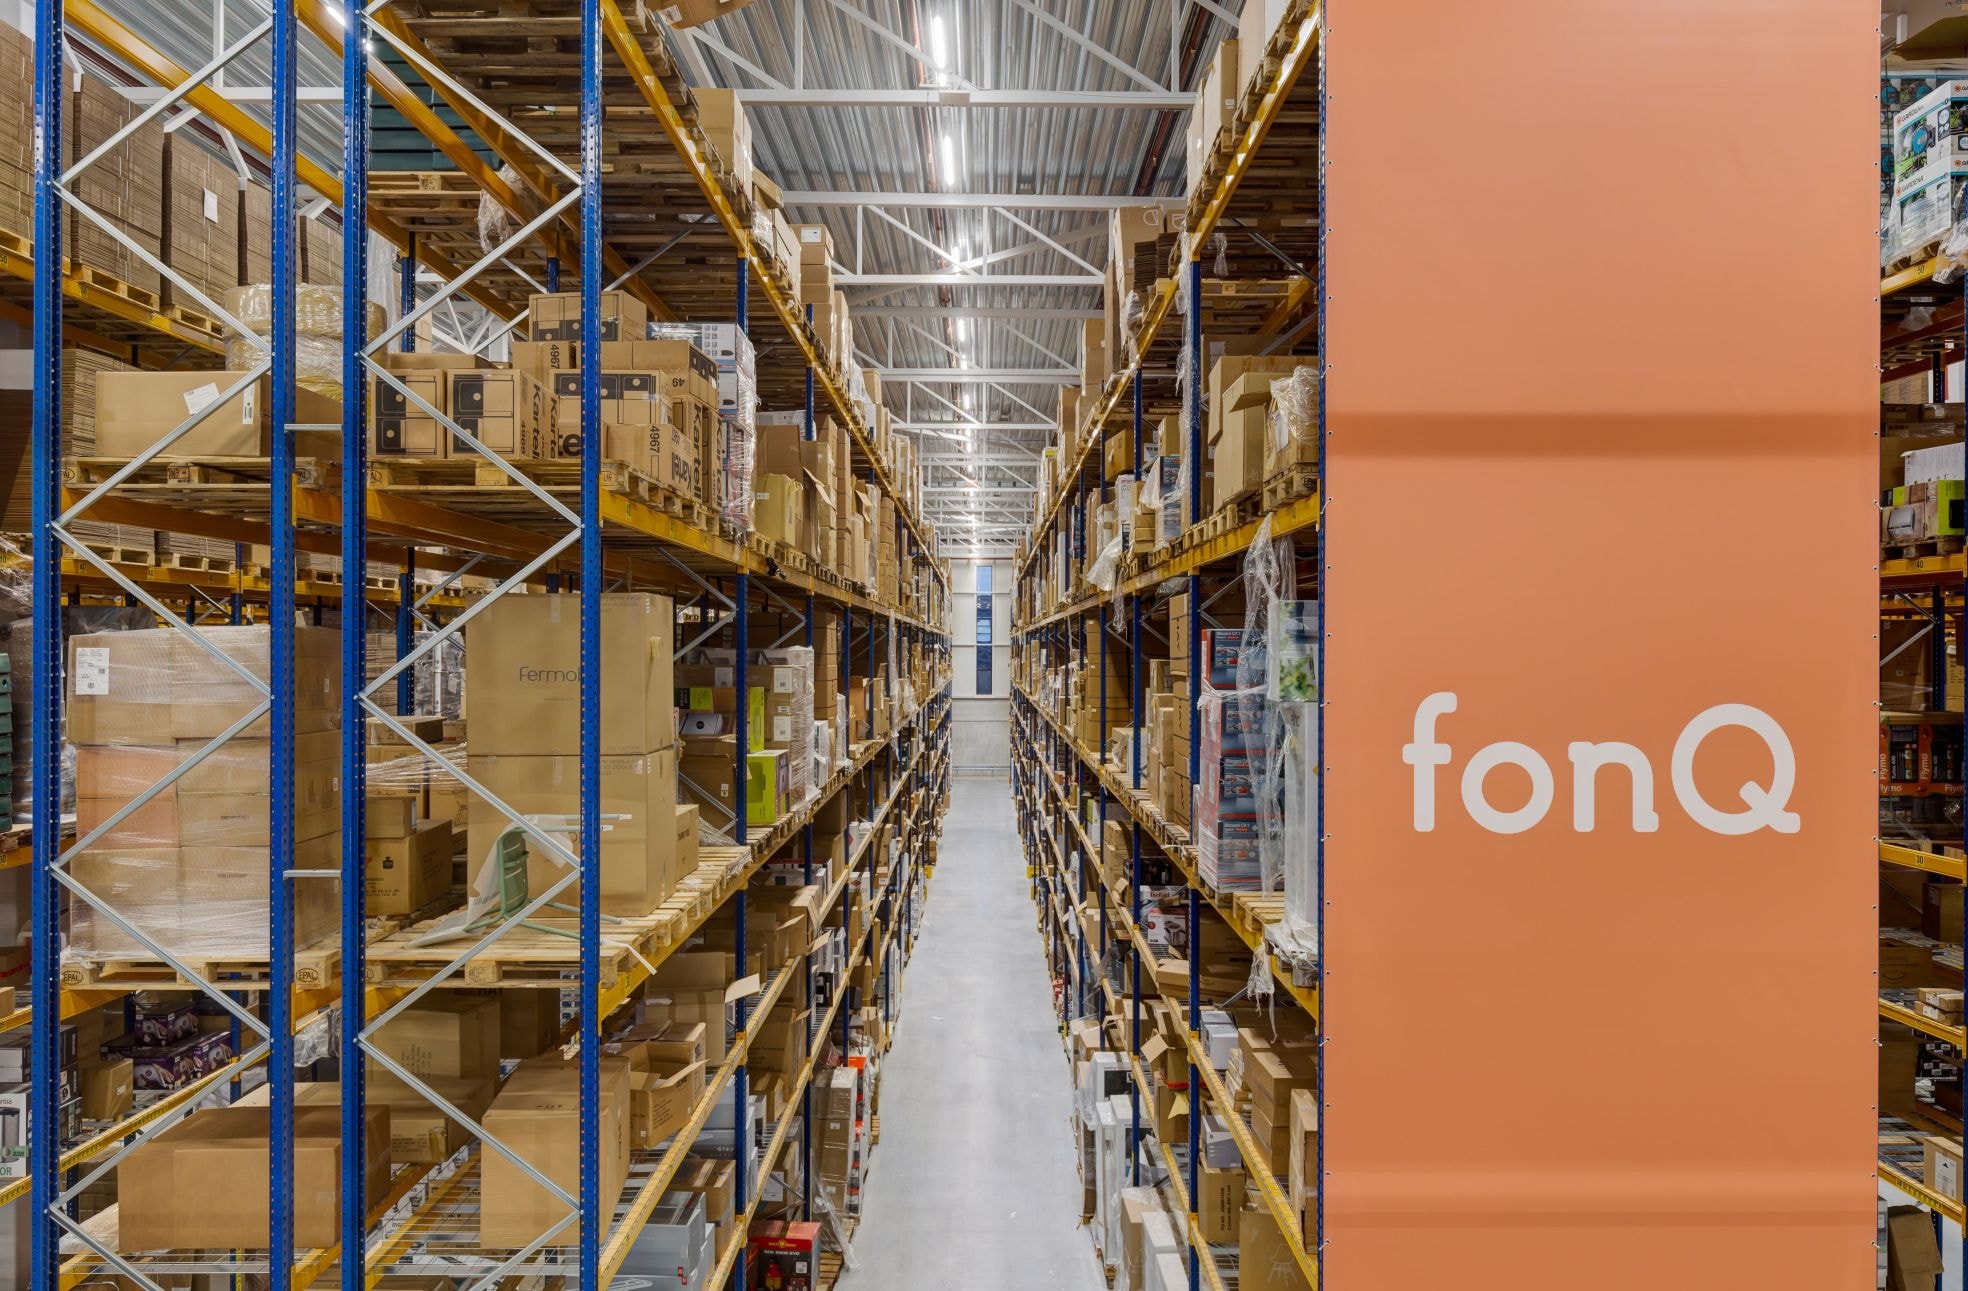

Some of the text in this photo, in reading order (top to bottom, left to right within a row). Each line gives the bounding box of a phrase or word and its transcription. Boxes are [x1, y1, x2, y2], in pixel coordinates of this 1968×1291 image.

[550, 344, 560, 370] 4967
[550, 395, 558, 459] Karte
[649, 425, 660, 454] 4967
[694, 403, 702, 501] Kartell
[79, 564, 87, 572] 40
[1915, 560, 1924, 569] 40
[519, 666, 581, 682] Fermo
[1402, 692, 1801, 835] fonQ
[1920, 753, 1929, 780] Flymo
[1880, 784, 1902, 794] lymo
[1944, 784, 1965, 794] Flym
[1915, 854, 1924, 865] 30
[63, 972, 81, 983] EPAL
[298, 970, 319, 981] EPAL
